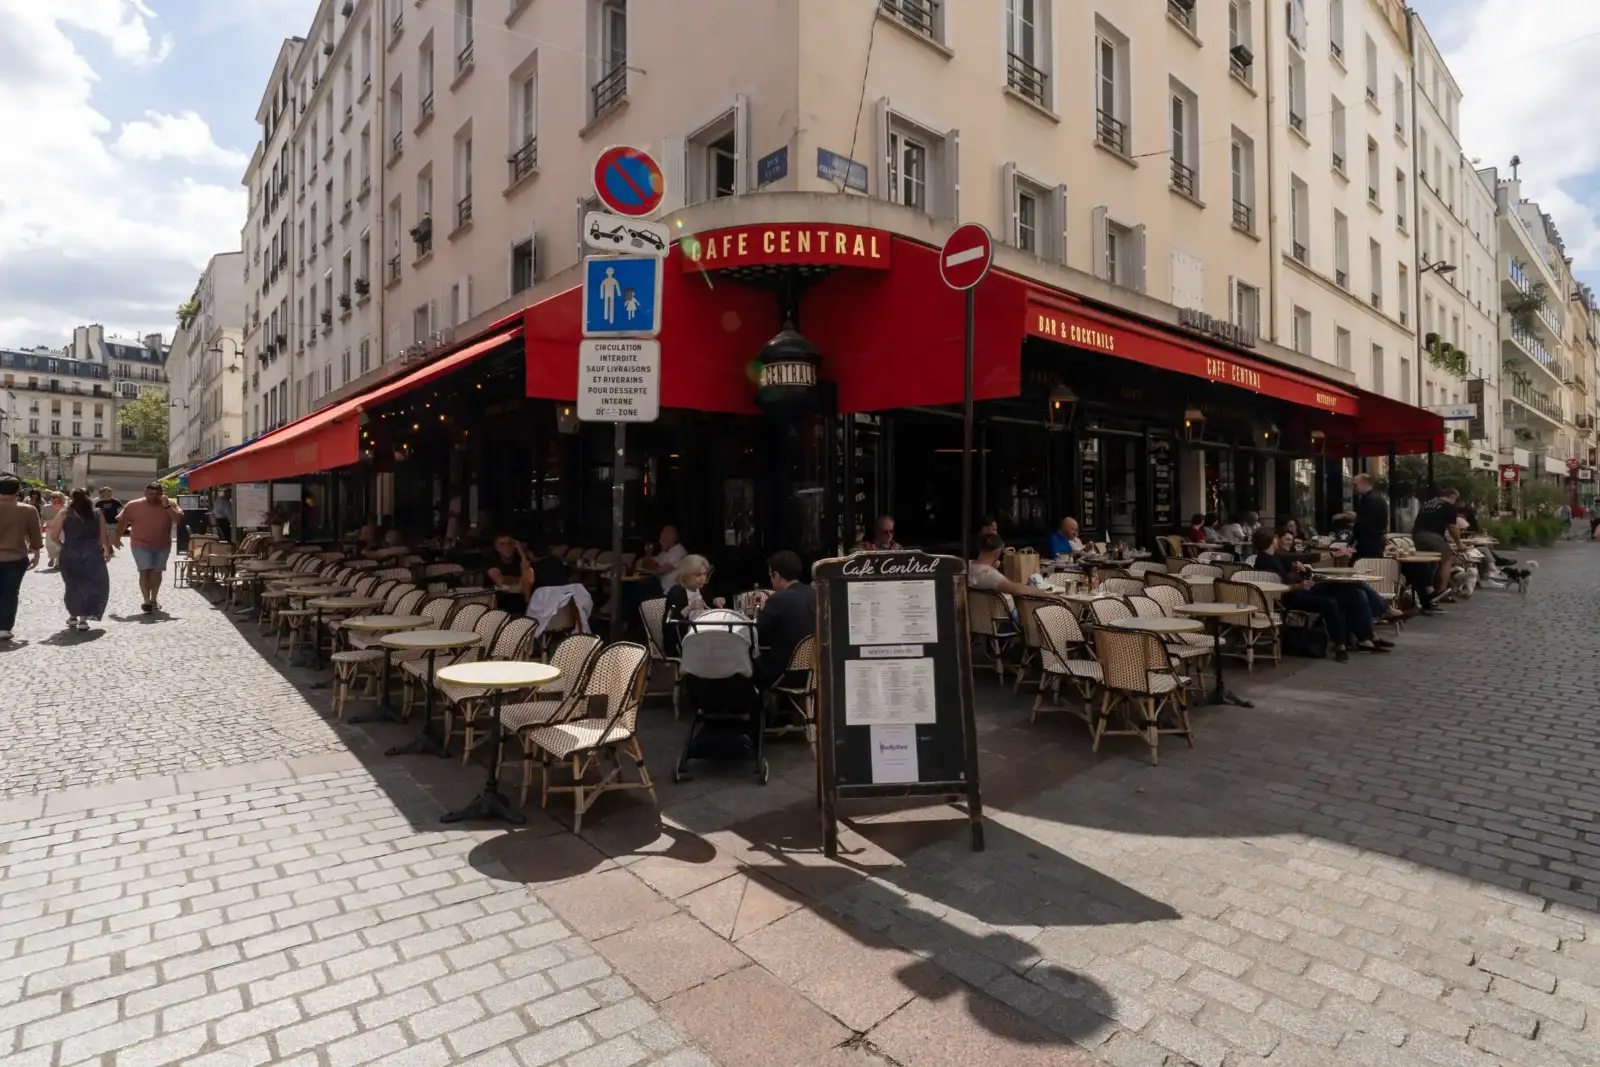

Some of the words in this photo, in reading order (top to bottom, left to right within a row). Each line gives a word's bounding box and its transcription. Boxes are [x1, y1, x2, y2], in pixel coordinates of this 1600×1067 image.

[691, 233, 748, 262] CAFE
[763, 231, 881, 258] CENTRAL
[1038, 315, 1056, 336] BAR
[1061, 322, 1067, 338] &
[1071, 325, 1114, 351] COCKTAILS
[600, 354, 638, 362] INTERDITE
[586, 365, 605, 373] SAUF
[607, 365, 651, 373] LIVRAISONS
[1207, 358, 1225, 379] CAFE
[1232, 364, 1261, 389] CENTRAL
[603, 376, 644, 384] RIVERAINS
[609, 387, 648, 395] DESSERTE
[618, 408, 638, 416] ZONE
[880, 556, 940, 574] Central
